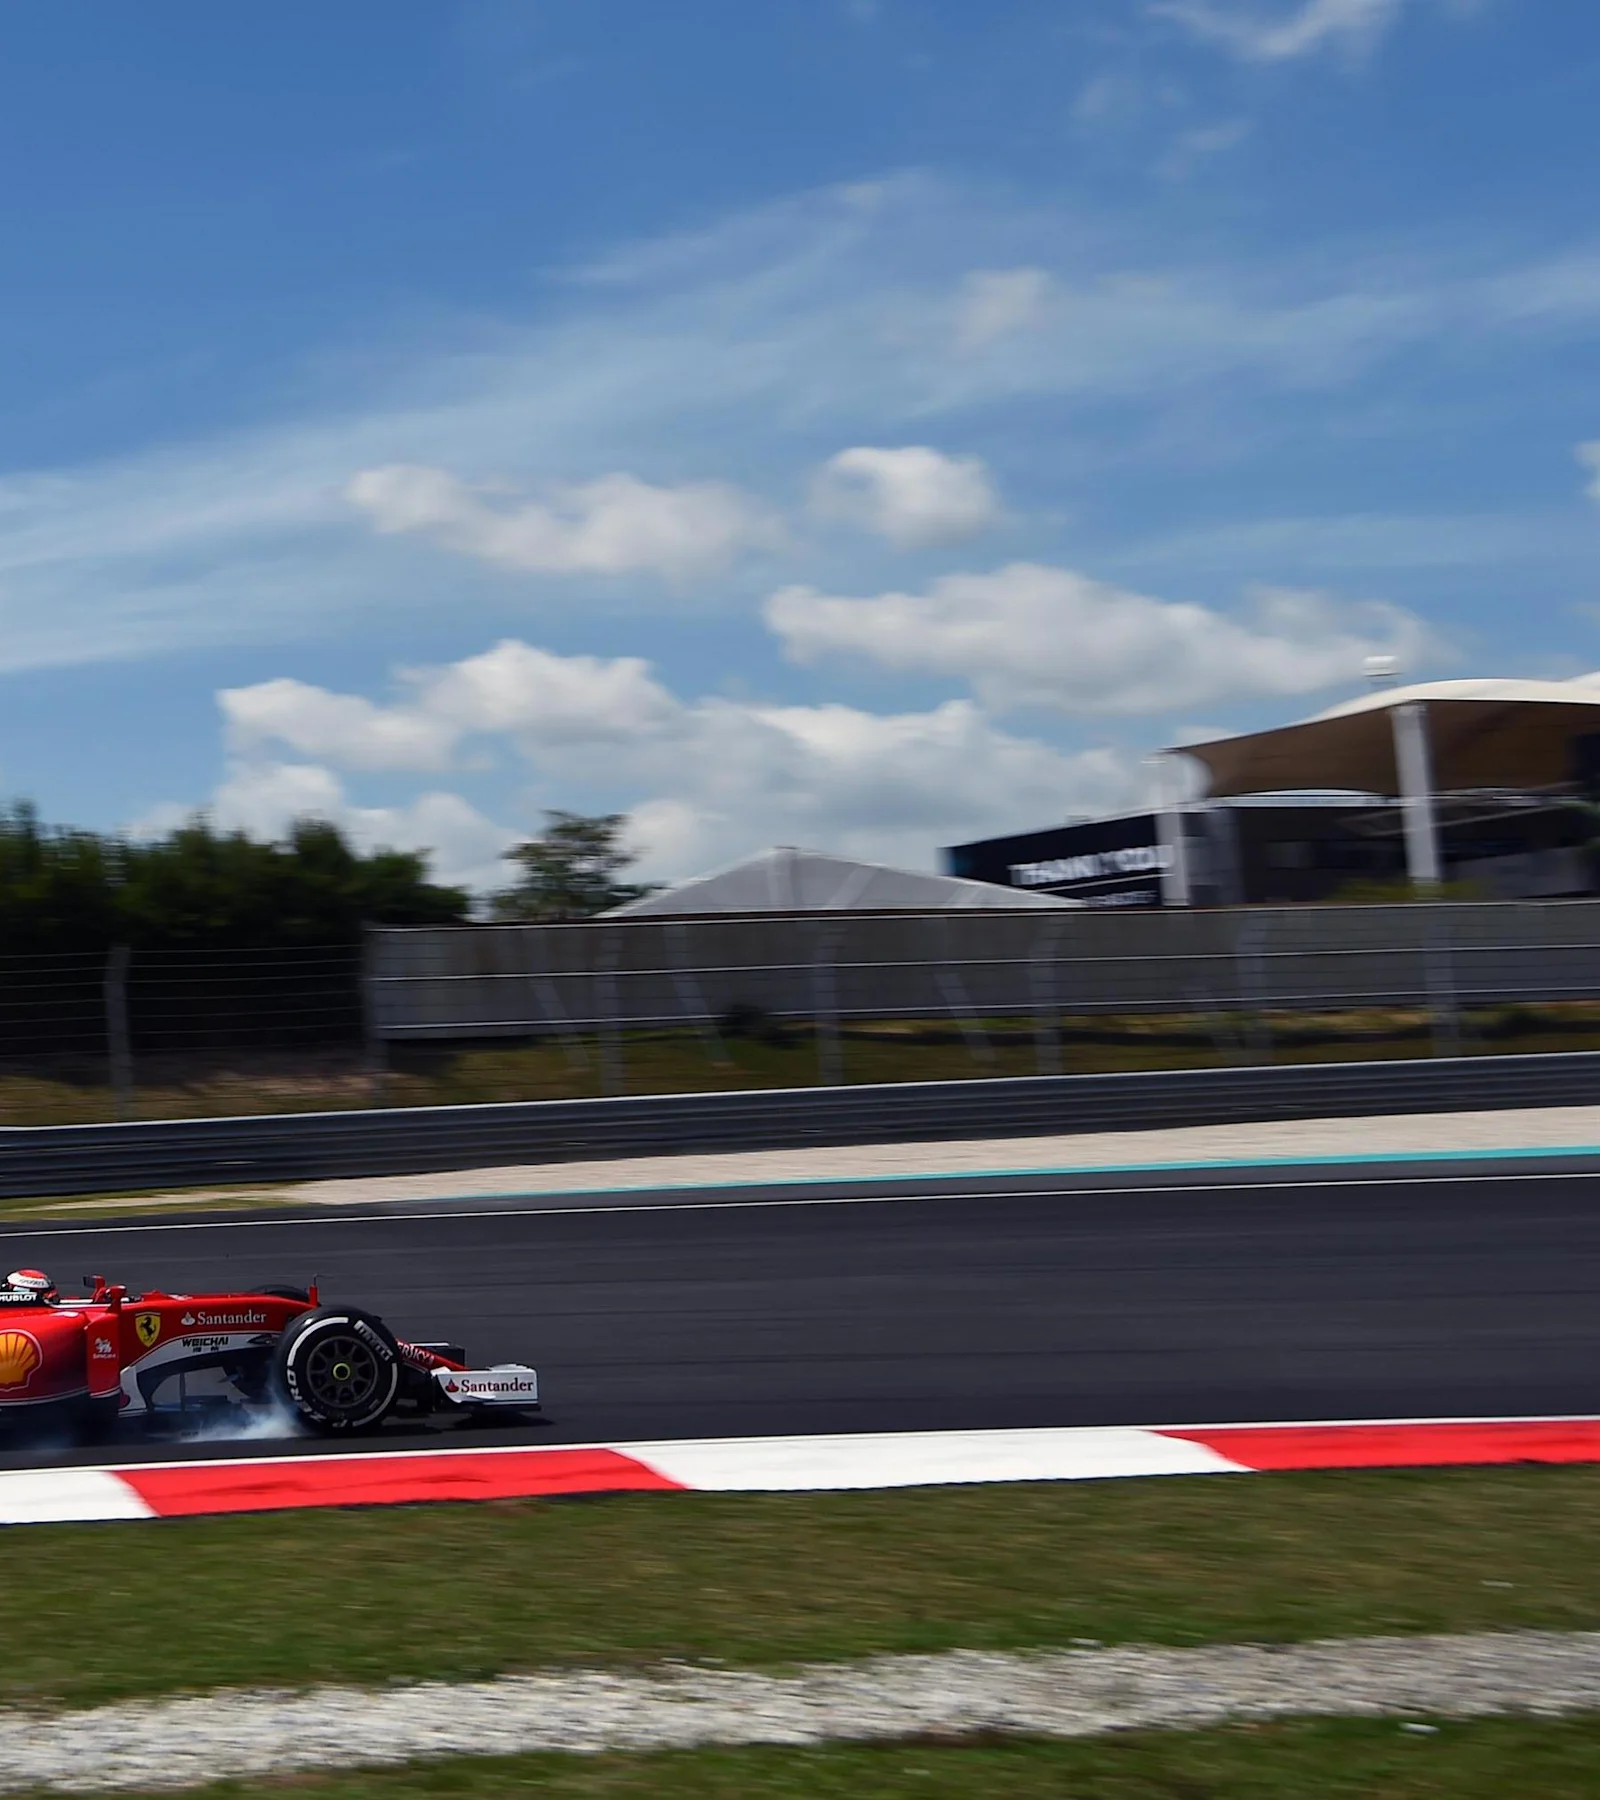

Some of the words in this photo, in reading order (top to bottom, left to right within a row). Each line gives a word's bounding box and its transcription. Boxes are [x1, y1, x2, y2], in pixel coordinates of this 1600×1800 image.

[197, 1309, 267, 1325] Santander
[182, 1336, 229, 1347] WEICHAI
[461, 1377, 534, 1393] Santander
